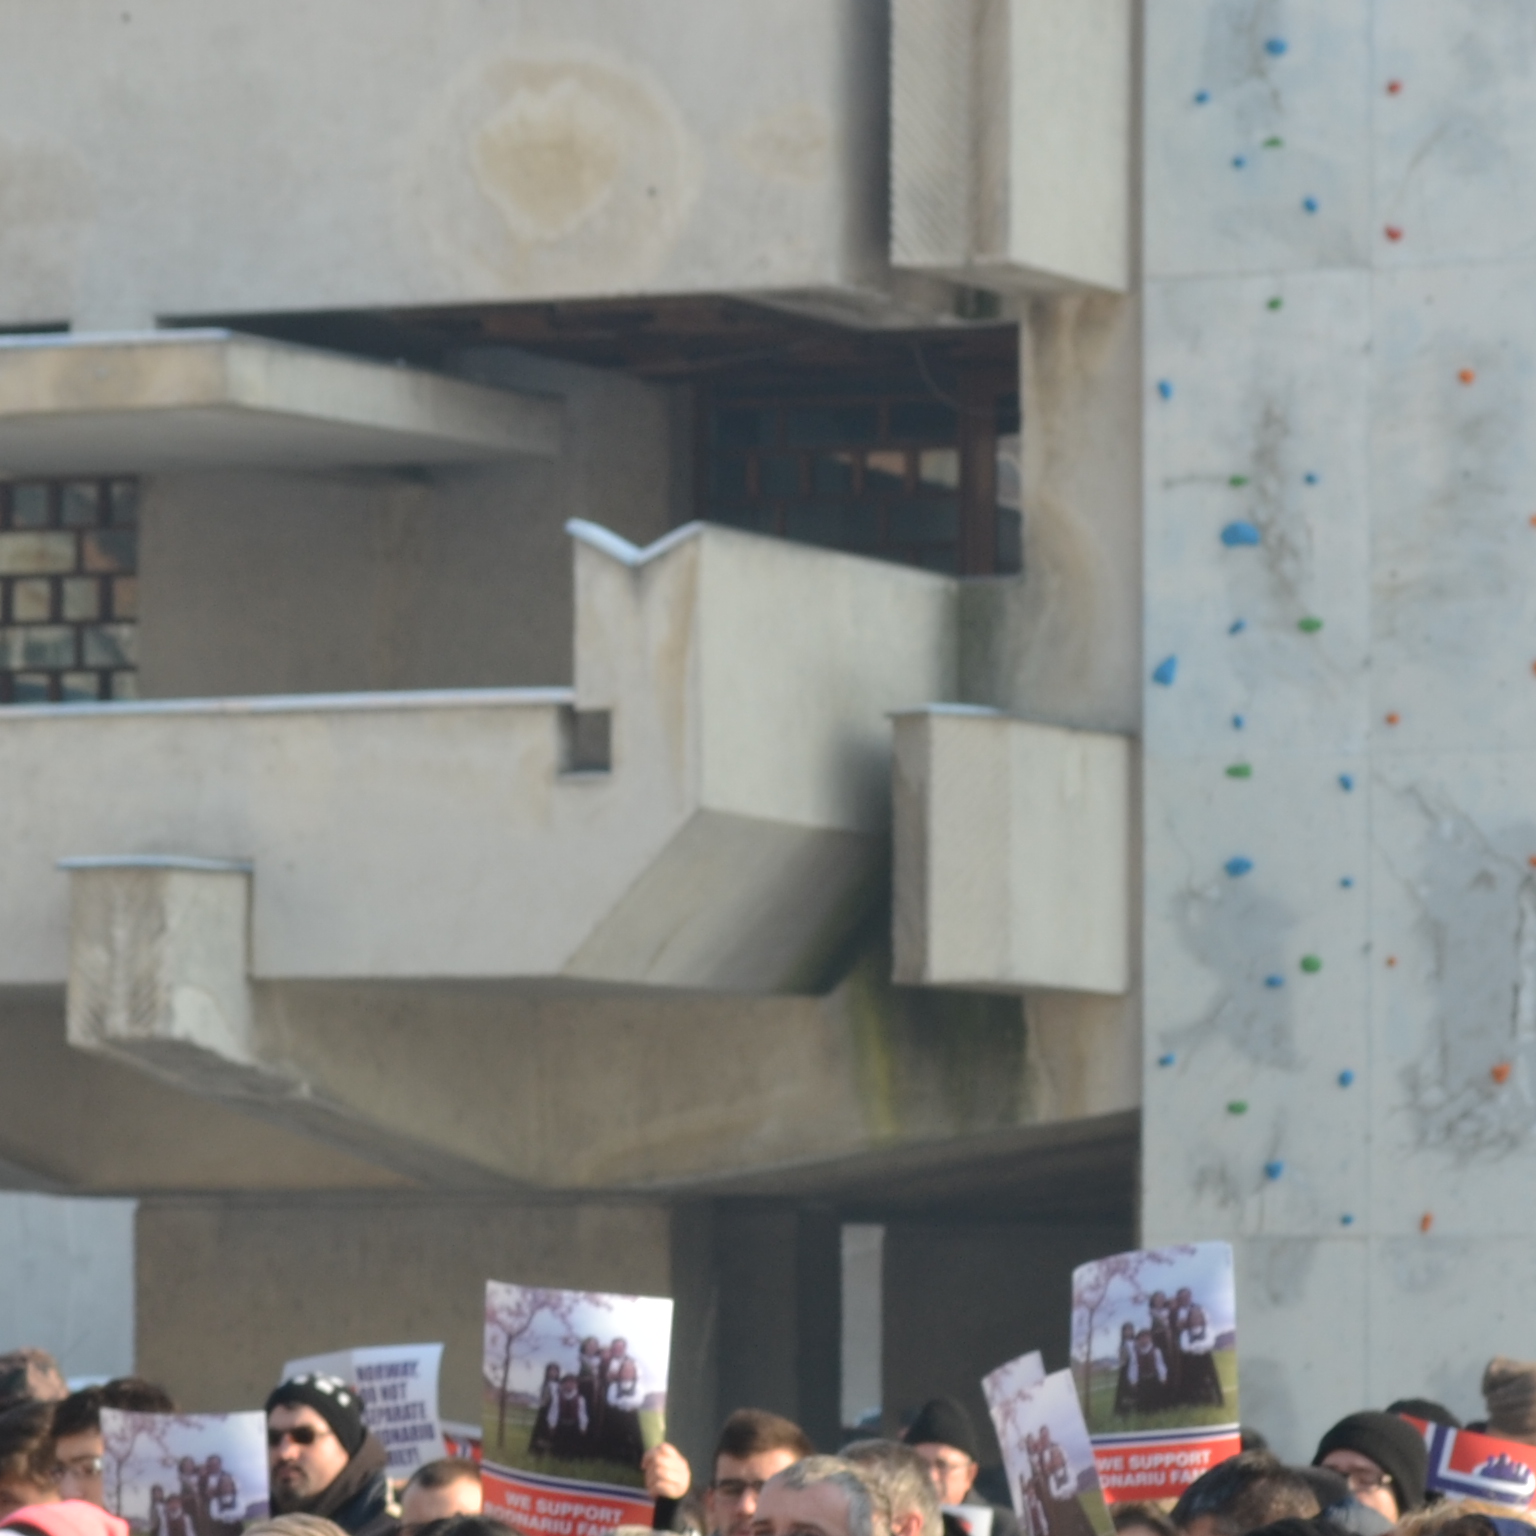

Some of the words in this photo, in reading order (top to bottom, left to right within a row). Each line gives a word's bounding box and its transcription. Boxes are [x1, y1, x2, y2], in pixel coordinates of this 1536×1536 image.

[1129, 1450, 1212, 1471] SUPPORT
[505, 1492, 532, 1509] WE
[536, 1498, 623, 1522] SUPPORT
